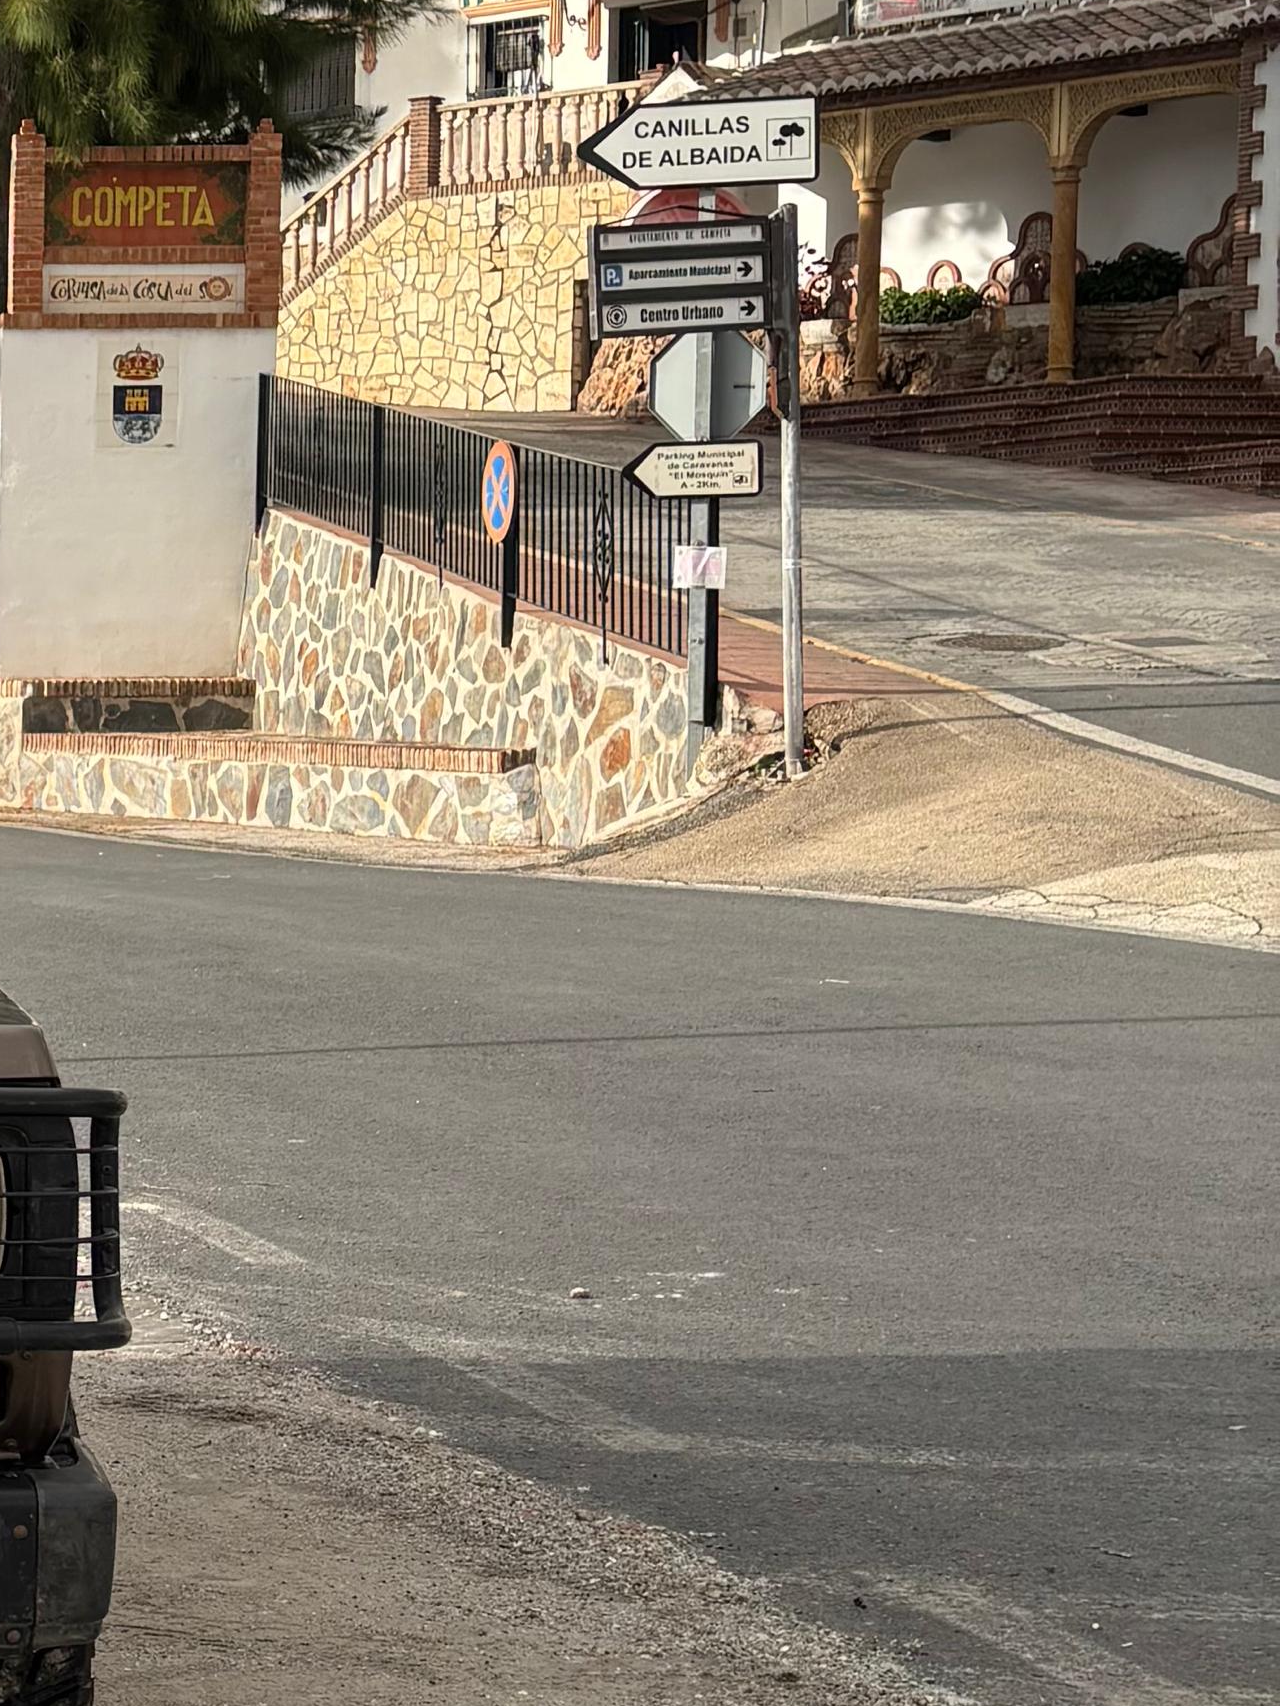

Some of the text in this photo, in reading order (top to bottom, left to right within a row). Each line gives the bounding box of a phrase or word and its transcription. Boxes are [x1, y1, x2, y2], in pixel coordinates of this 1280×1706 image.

[634, 115, 751, 139] CANILLAS
[622, 144, 763, 169] DE ALBAIDA
[685, 229, 695, 240] DE
[628, 266, 689, 281] Aparcamiento
[689, 264, 732, 277] Municipal
[640, 305, 724, 324] Centro Urbano
[657, 449, 745, 461] Parking Municipal
[667, 461, 734, 470] de Caravanas
[680, 481, 688, 489] A
